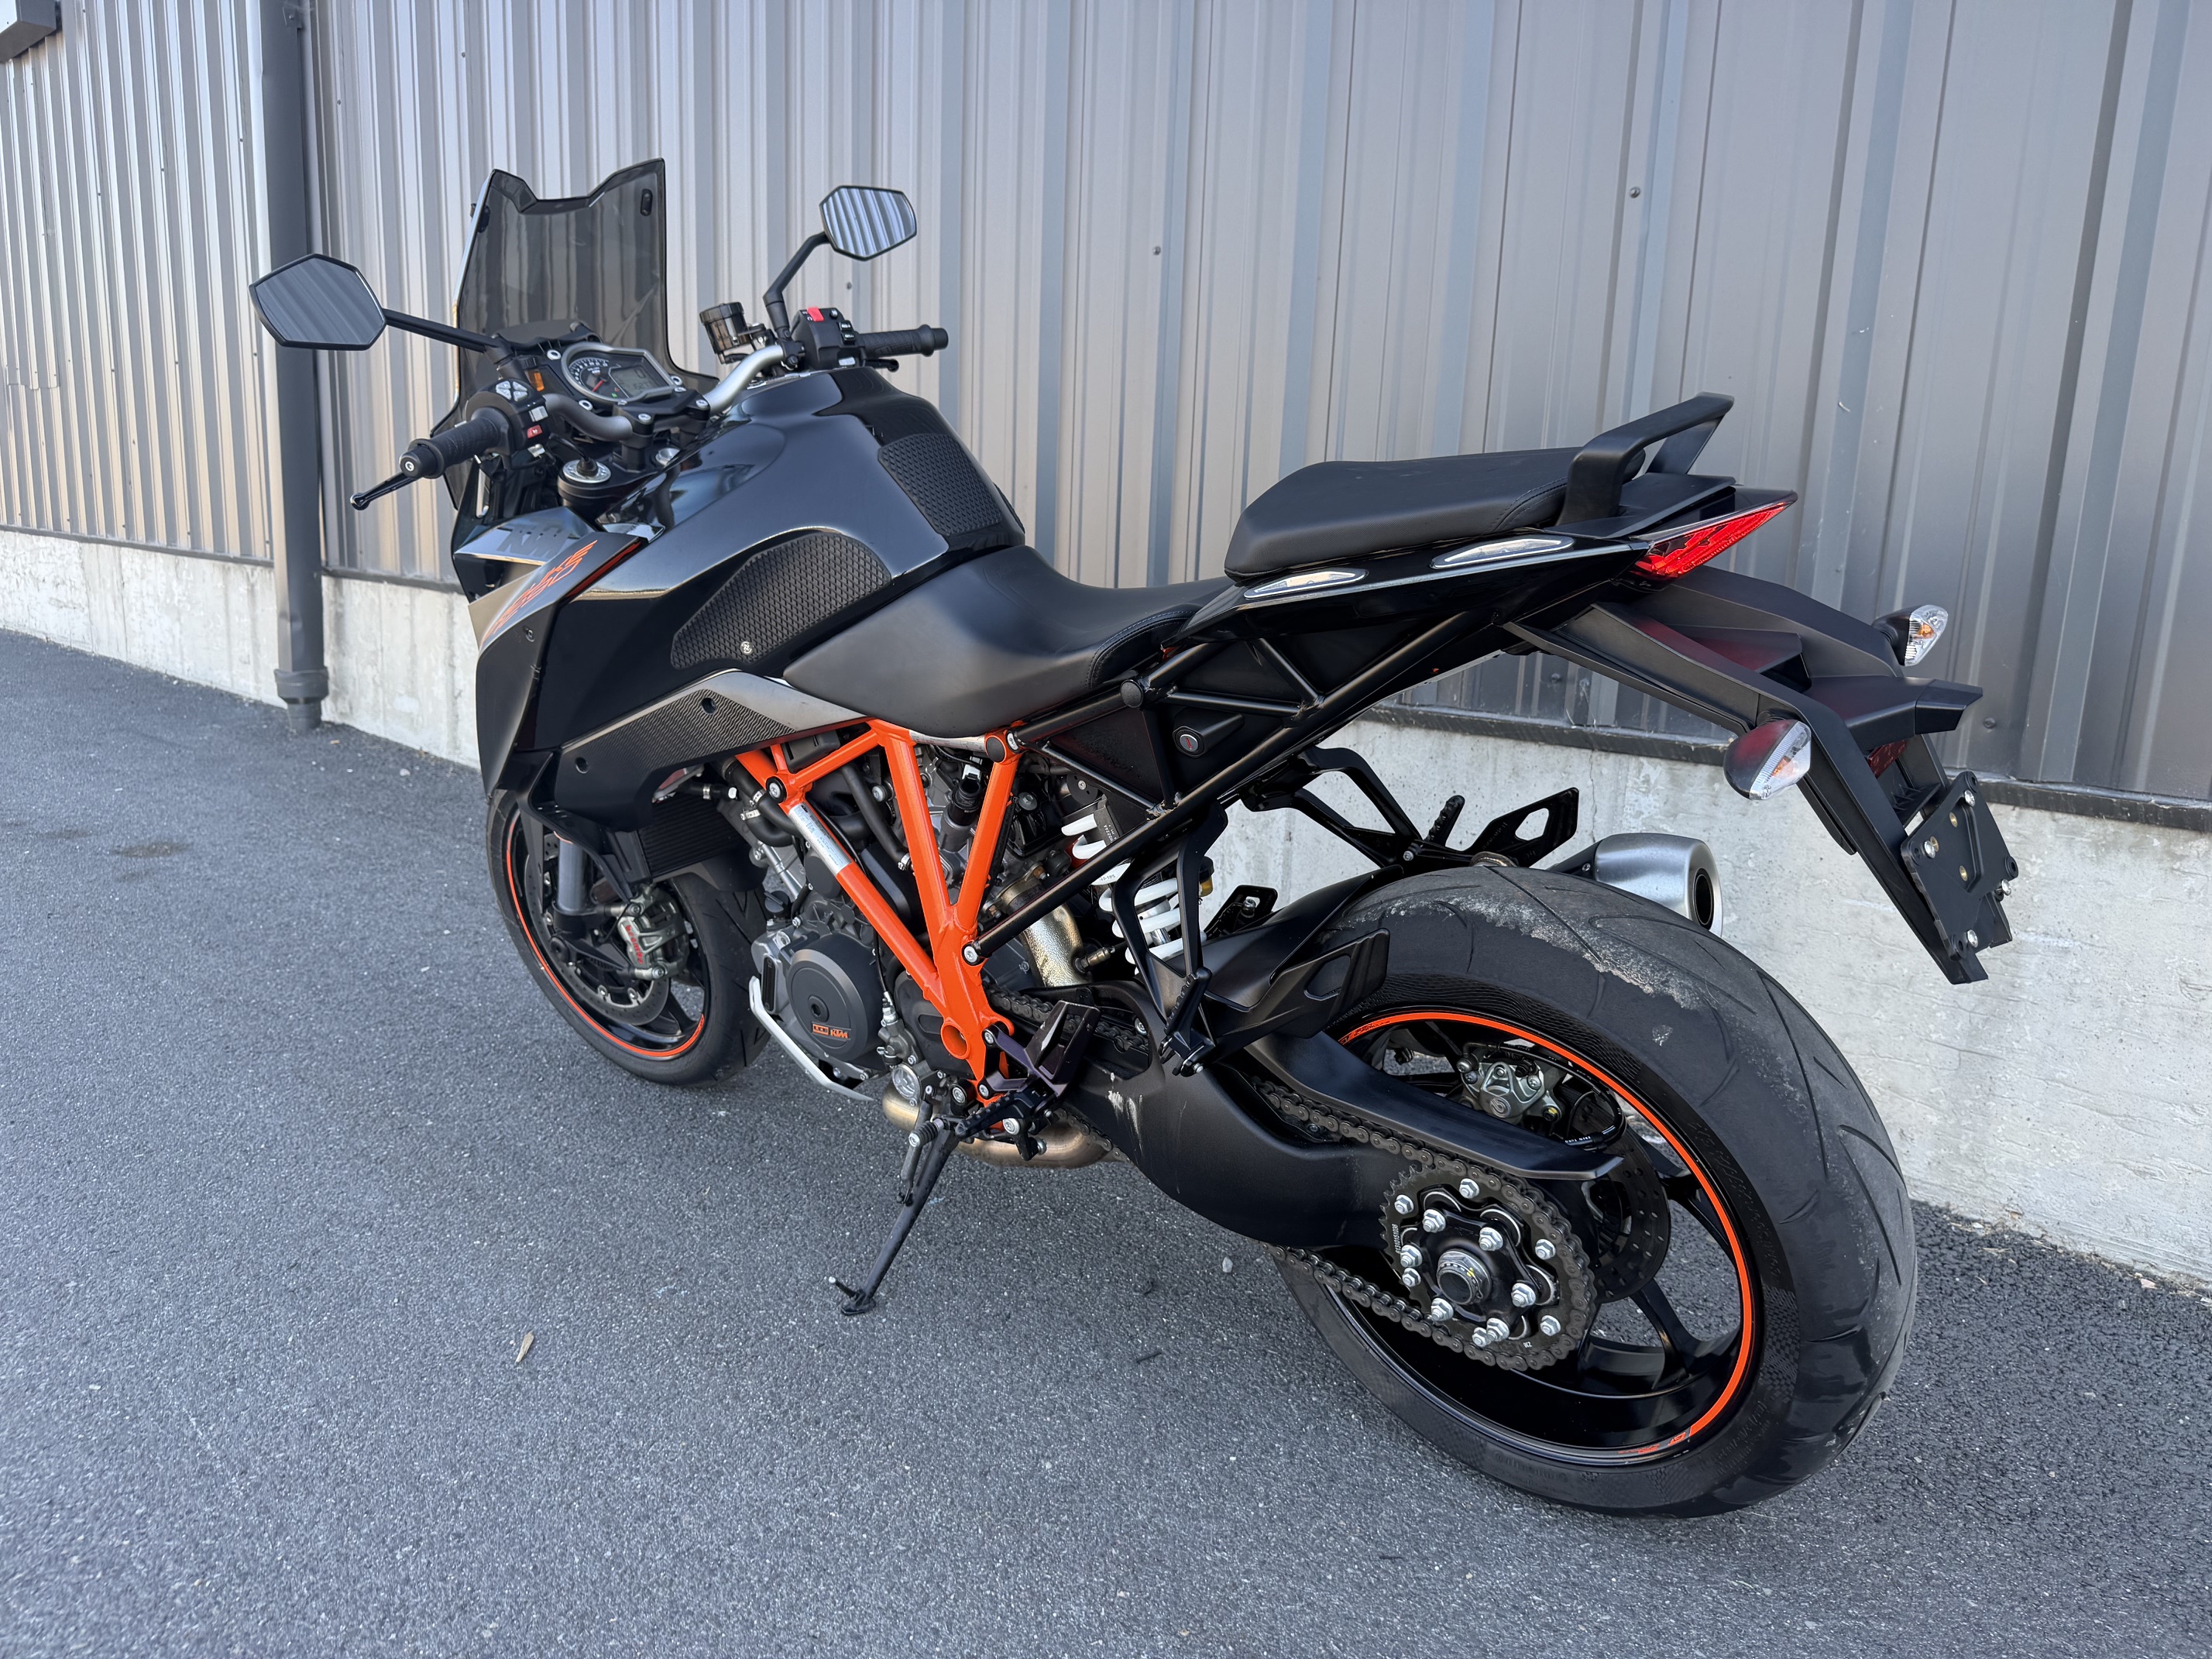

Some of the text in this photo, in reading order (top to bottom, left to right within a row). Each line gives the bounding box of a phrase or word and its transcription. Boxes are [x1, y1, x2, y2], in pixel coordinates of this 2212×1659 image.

[496, 524, 571, 560] KTM
[625, 925, 644, 965] brembo
[830, 1029, 849, 1039] KTM
